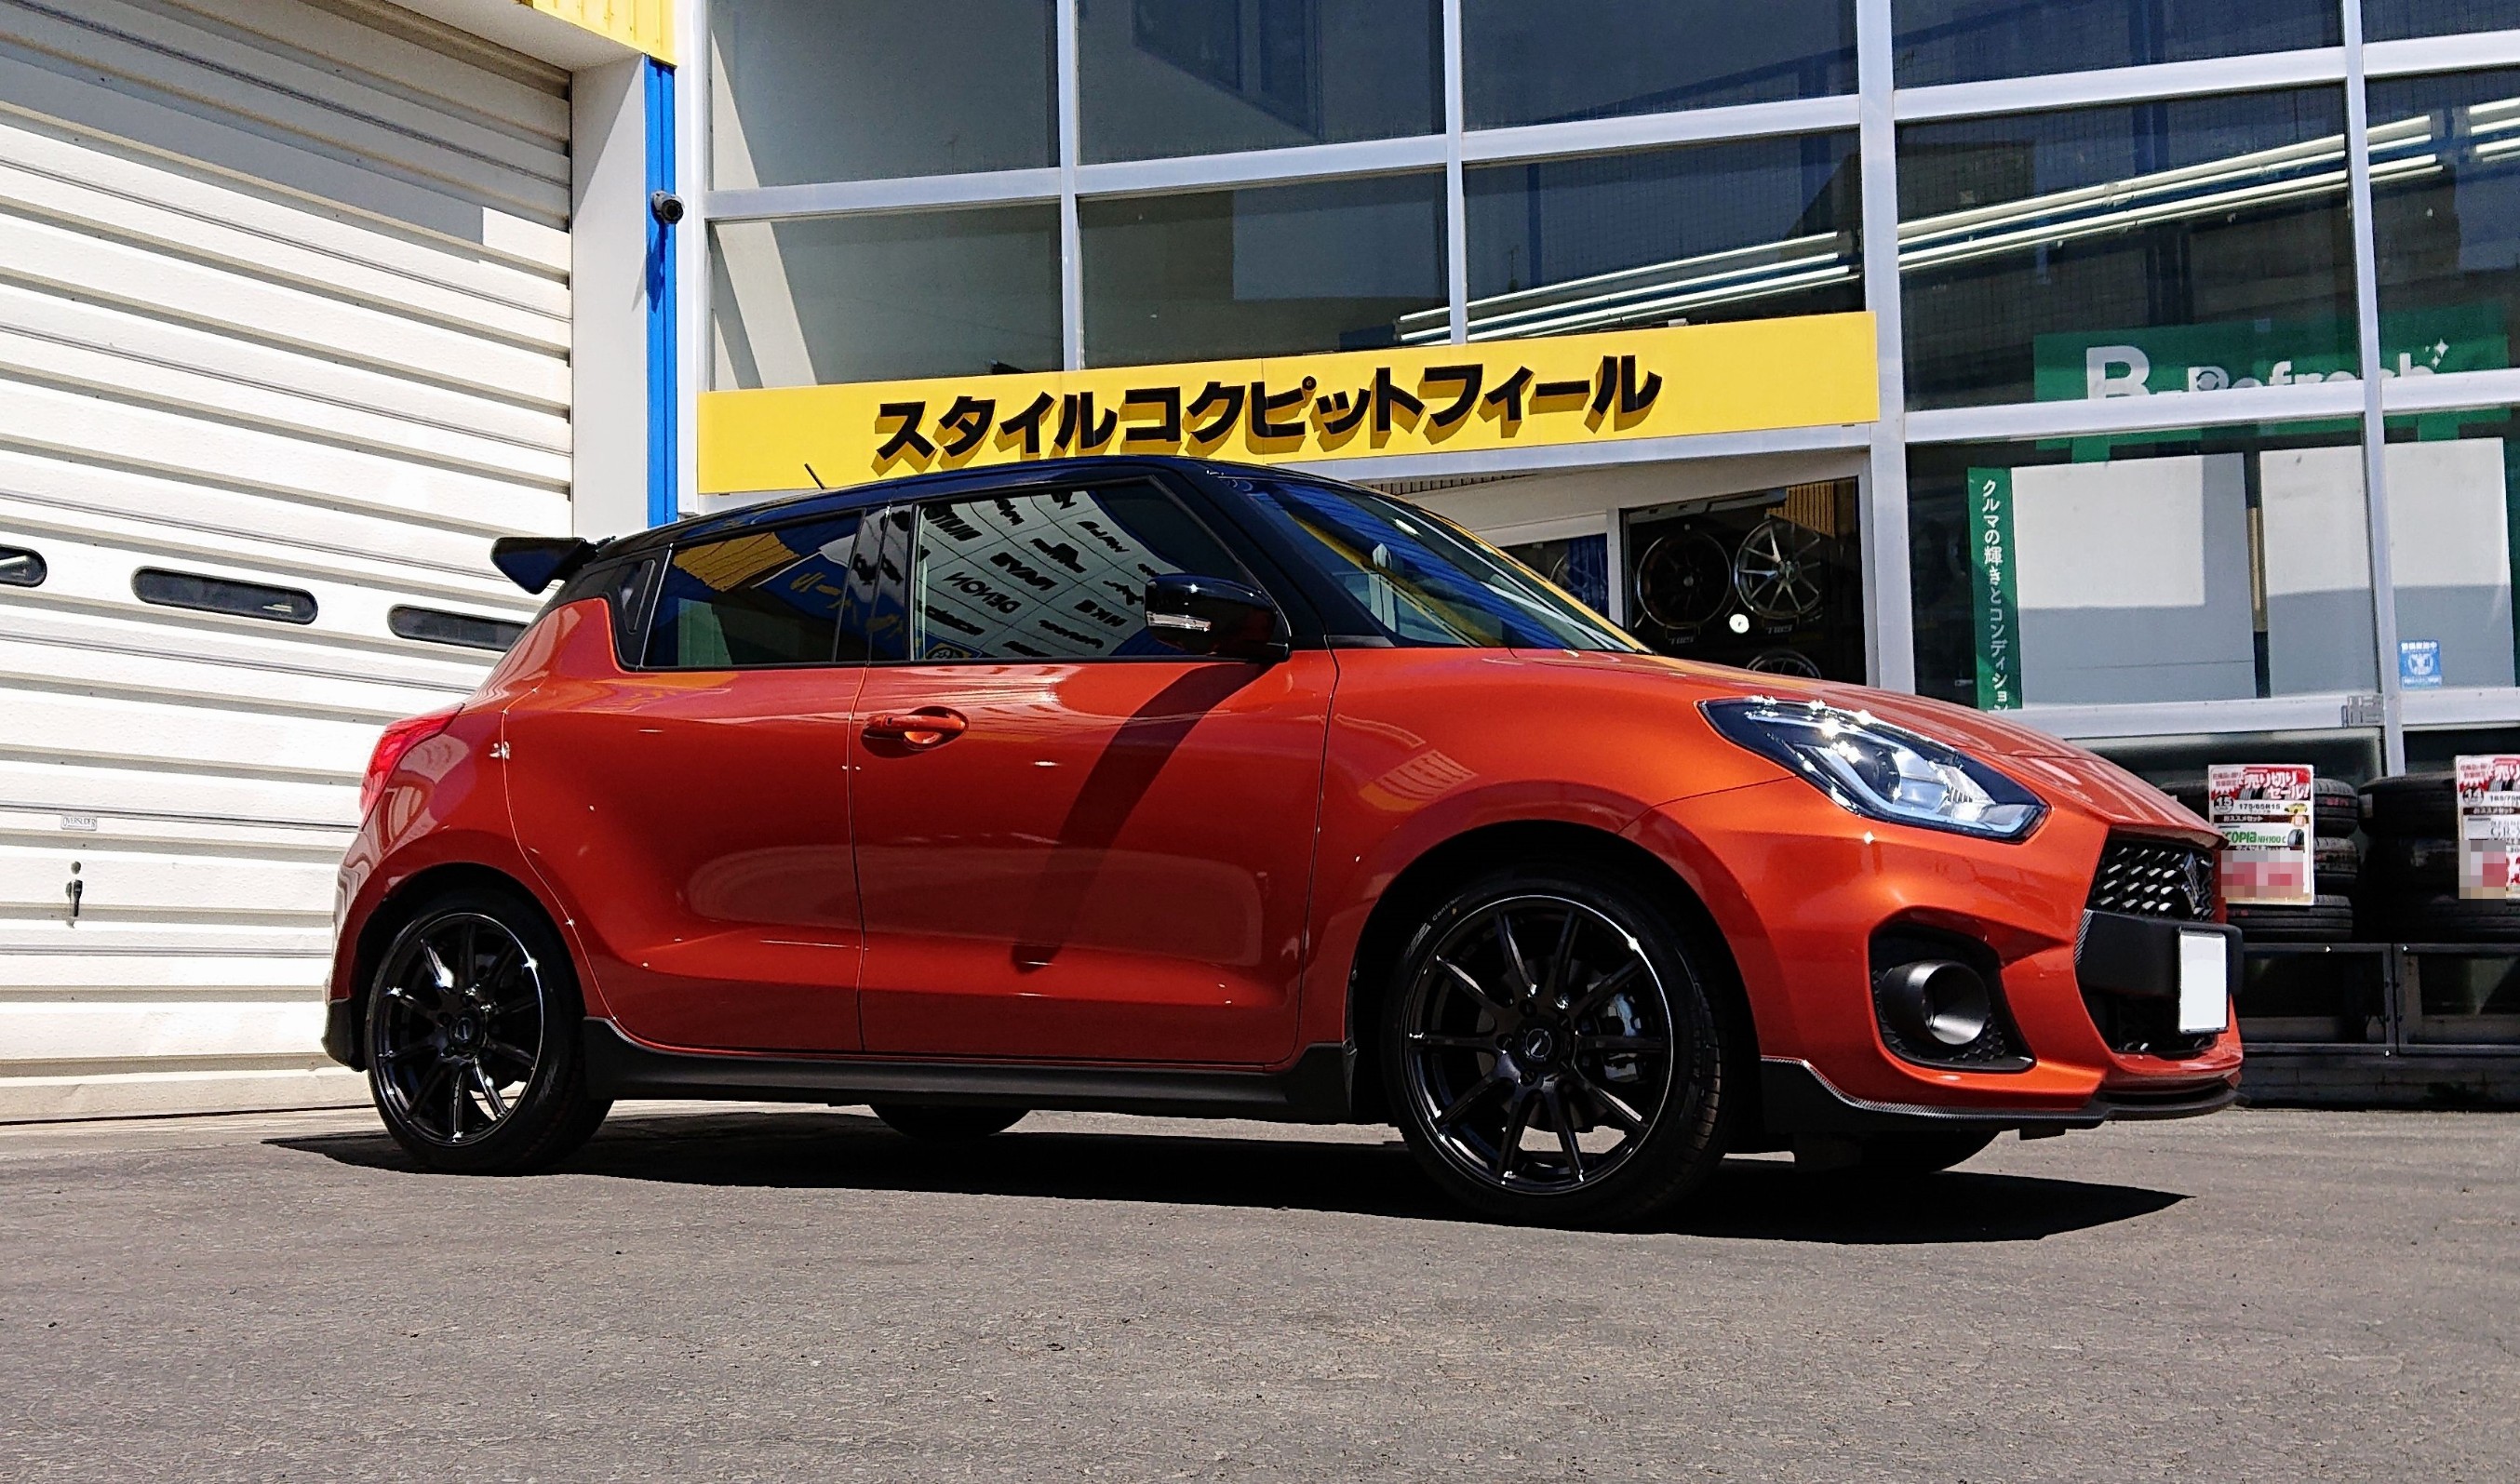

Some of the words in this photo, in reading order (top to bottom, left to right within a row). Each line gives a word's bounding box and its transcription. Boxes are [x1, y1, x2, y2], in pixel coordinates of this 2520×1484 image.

[877, 354, 1663, 465] スタイルコクピットフィール
[2244, 771, 2297, 789] 売り切り
